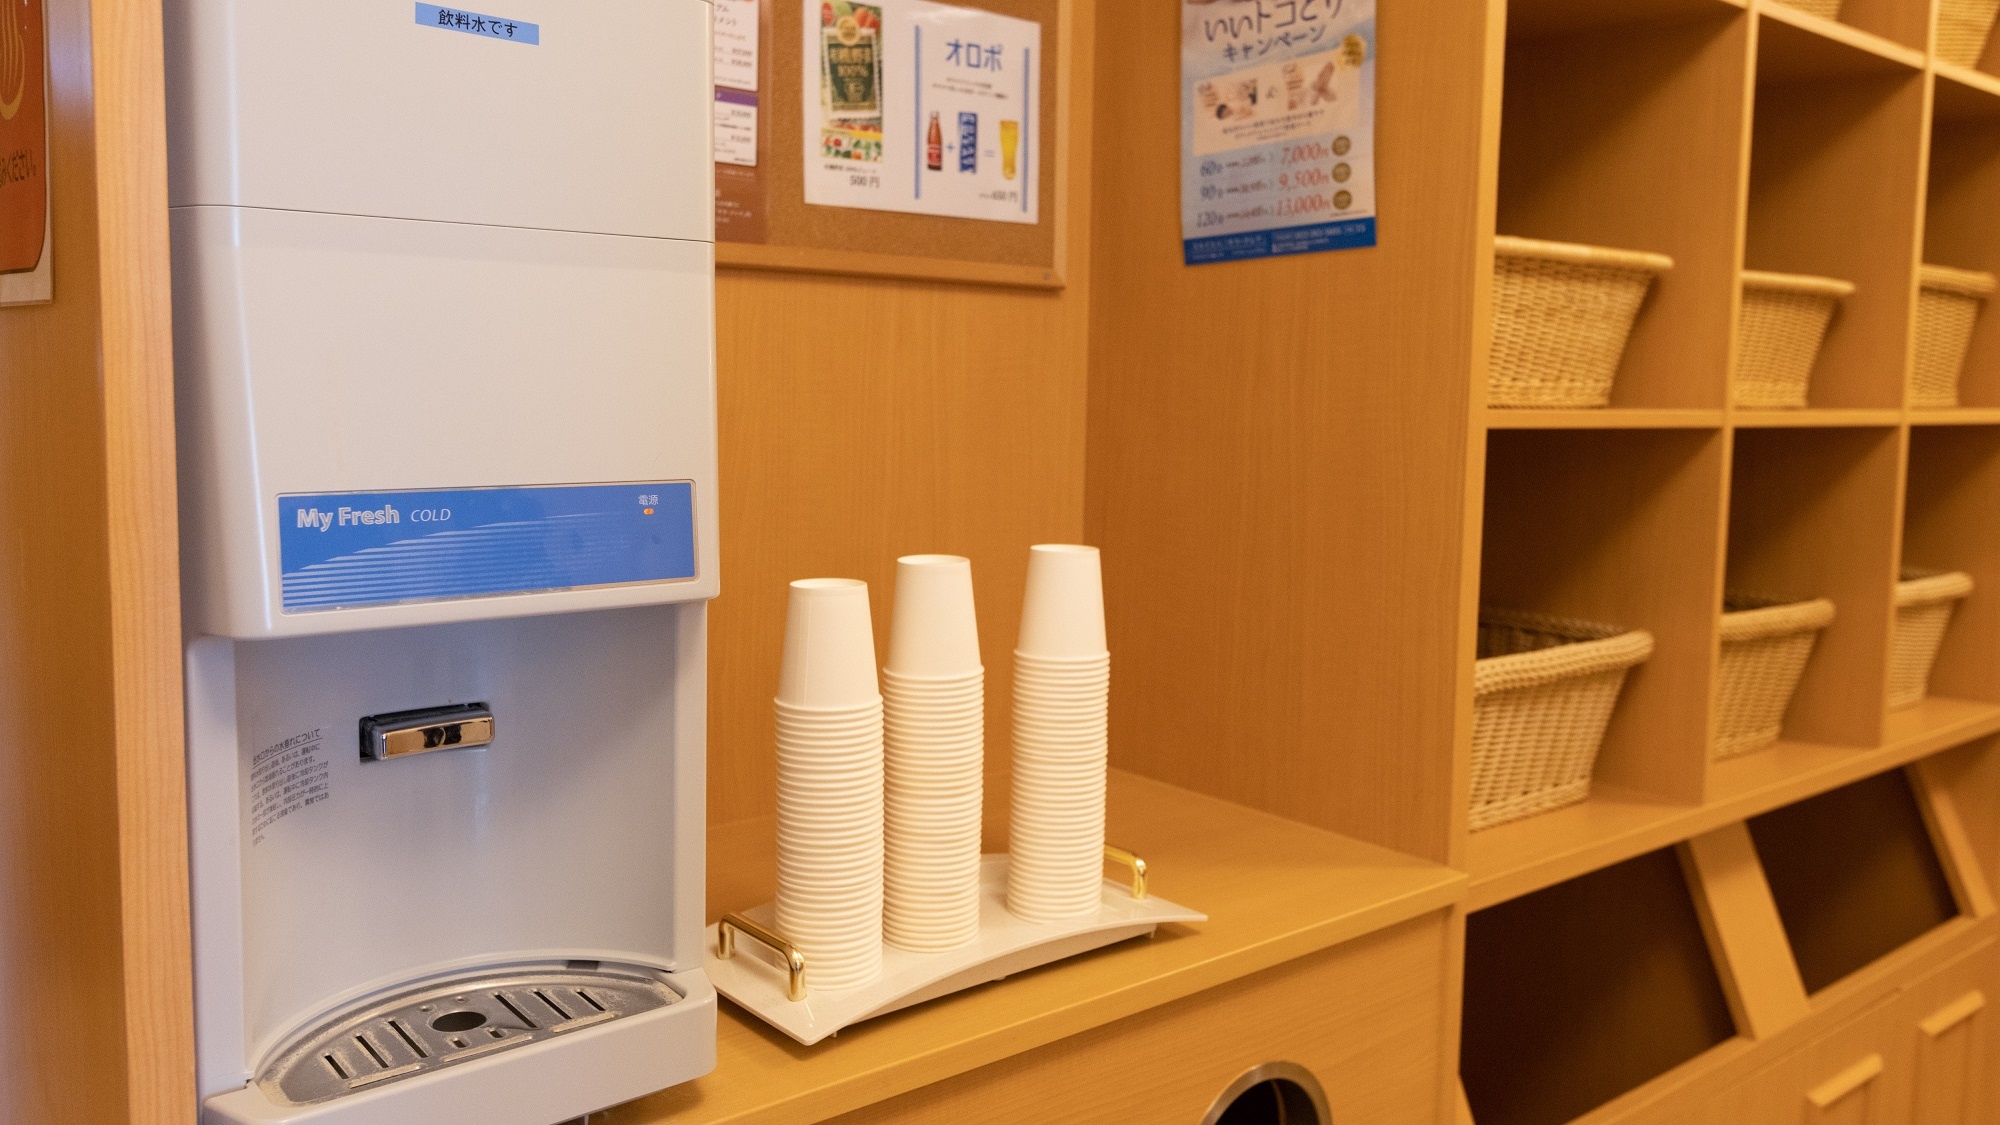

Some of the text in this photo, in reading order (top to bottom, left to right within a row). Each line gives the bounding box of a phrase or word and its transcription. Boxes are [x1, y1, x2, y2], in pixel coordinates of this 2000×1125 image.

[438, 9, 518, 38] 飲料水です
[946, 39, 1004, 72] オロポ
[1223, 23, 1327, 63] キャンペーン
[638, 494, 659, 506] 電源
[297, 504, 451, 533] My Fresh COLD
